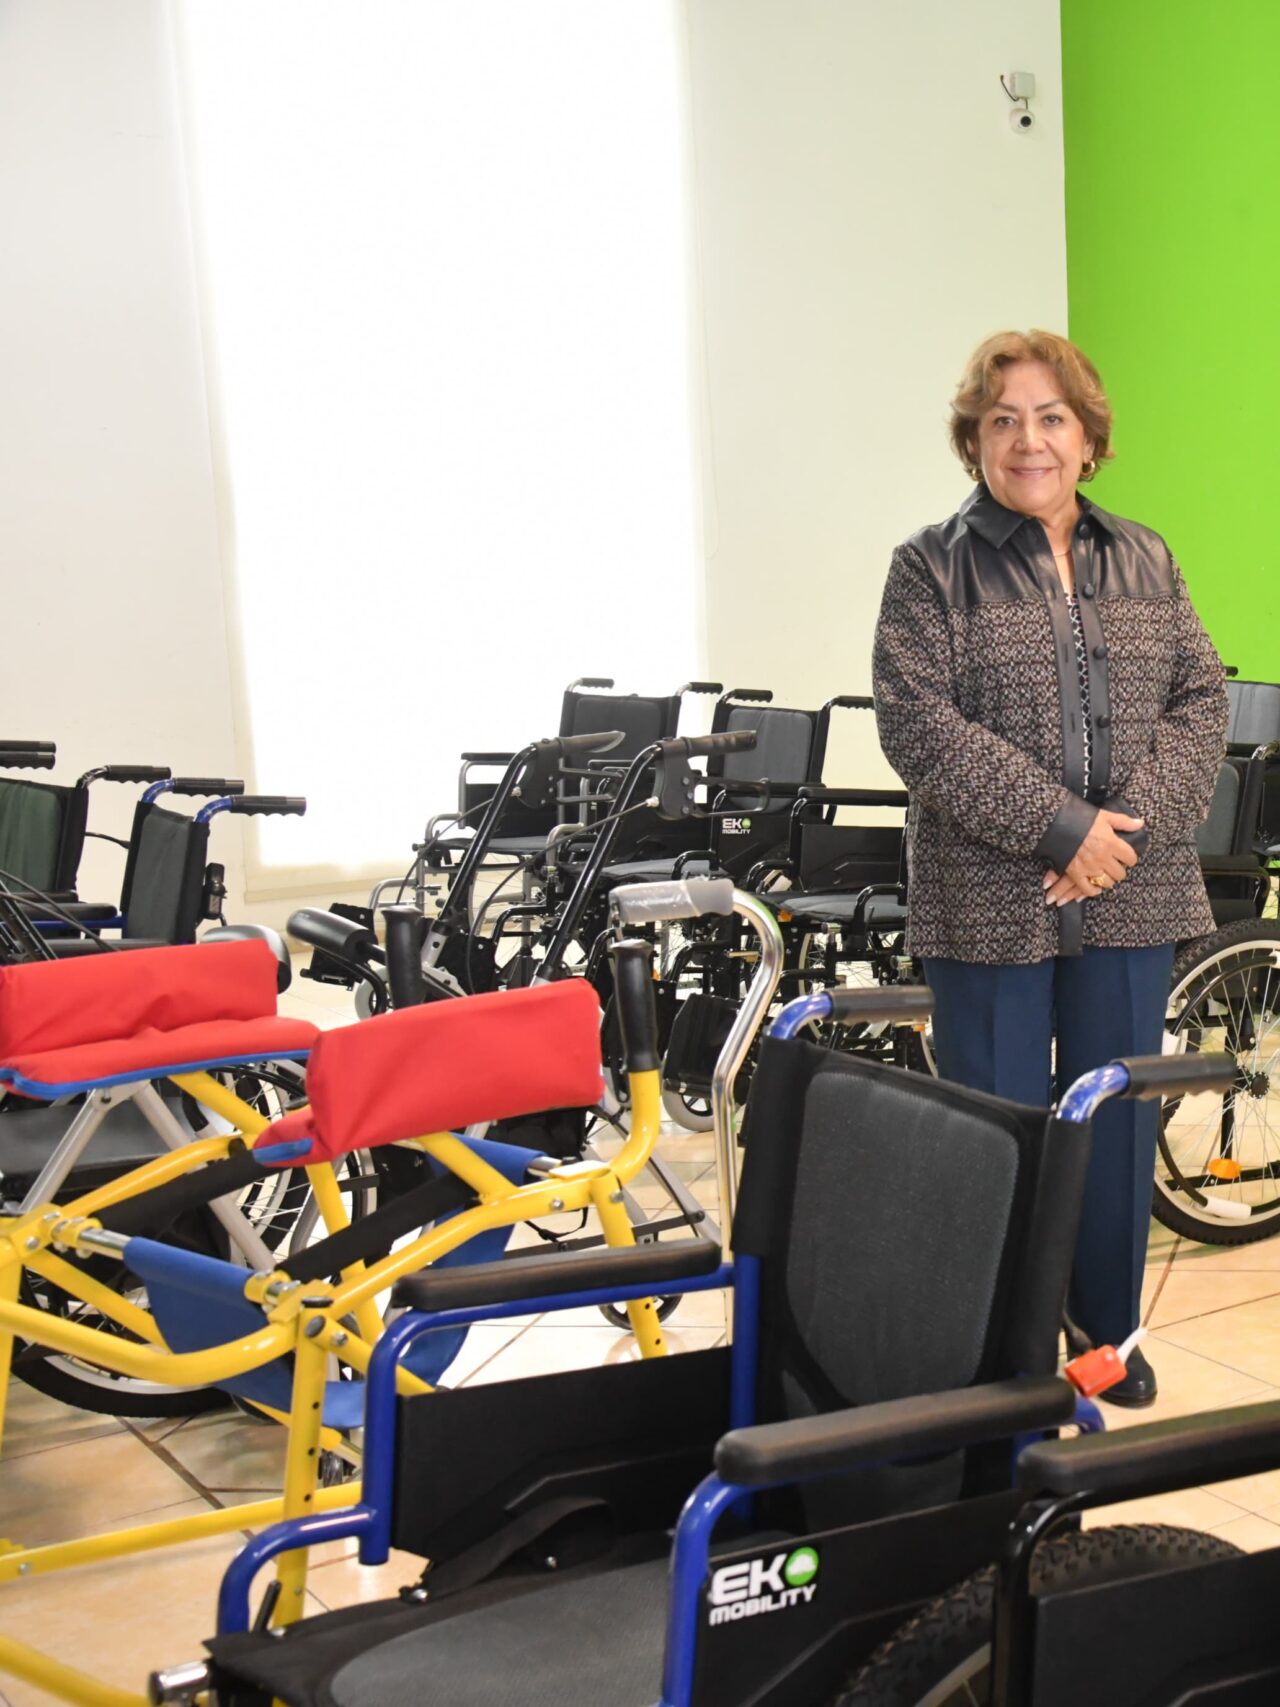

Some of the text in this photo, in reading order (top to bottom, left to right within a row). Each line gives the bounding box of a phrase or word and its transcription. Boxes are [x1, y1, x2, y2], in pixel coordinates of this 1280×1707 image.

[722, 818, 751, 829] EKO
[711, 1546, 819, 1606] EKO
[708, 1583, 817, 1626] MOBILITY
